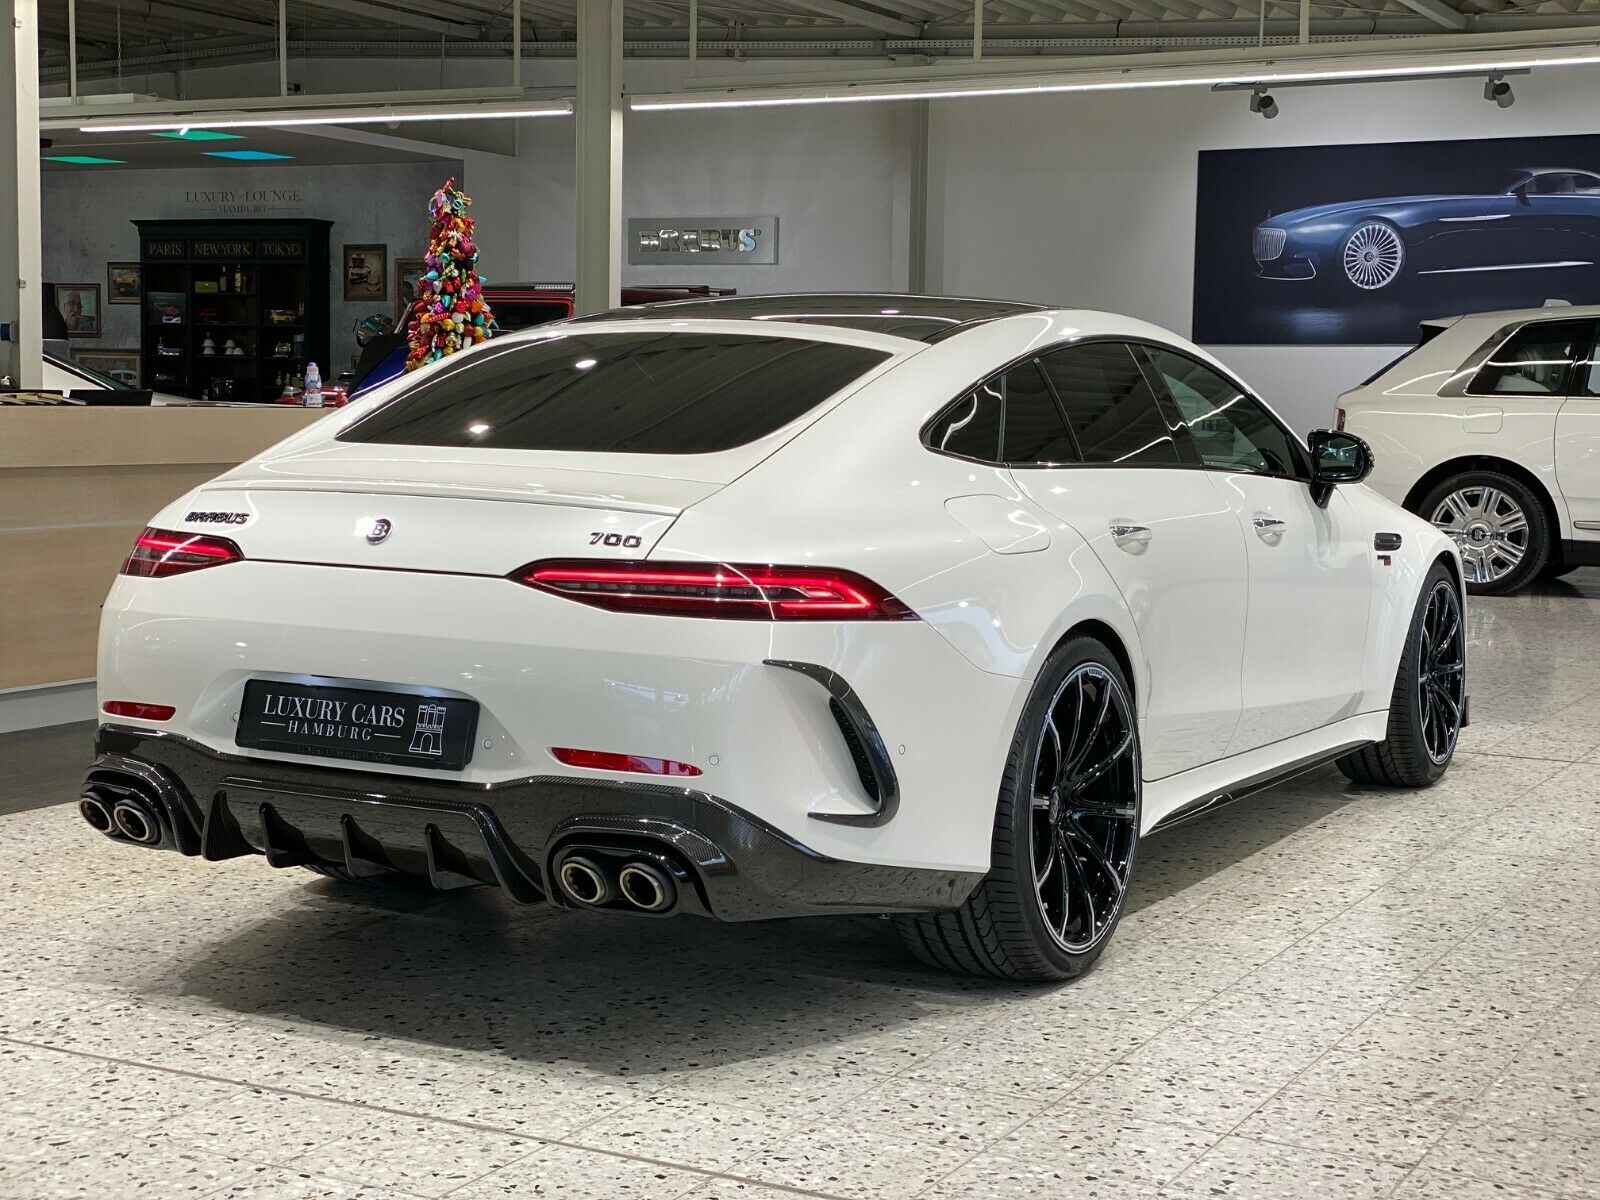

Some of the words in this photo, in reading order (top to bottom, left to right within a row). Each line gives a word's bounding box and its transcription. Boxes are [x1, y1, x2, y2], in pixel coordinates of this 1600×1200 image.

[185, 191, 237, 203] LUXURY
[245, 190, 302, 202] LOUNGE
[150, 241, 182, 256] PARIS
[263, 242, 301, 256] TOKYO
[185, 511, 250, 525] BRABUS
[589, 532, 642, 549] 700
[262, 694, 348, 722] LUXURY
[351, 702, 406, 728] CARS
[288, 720, 372, 741] HAMBURG
